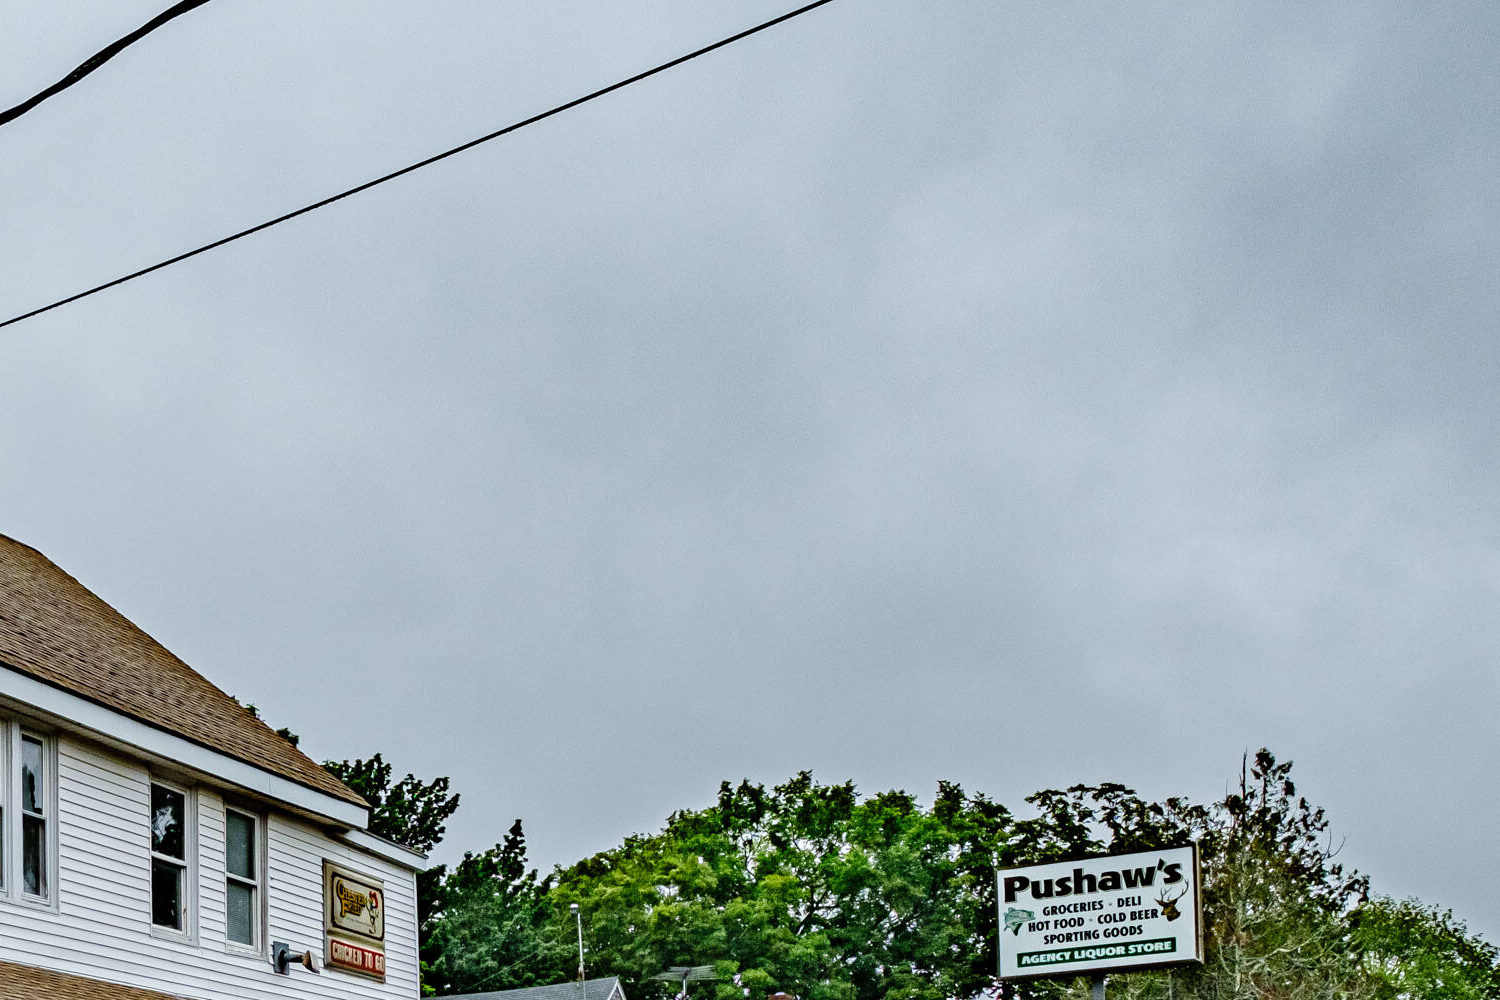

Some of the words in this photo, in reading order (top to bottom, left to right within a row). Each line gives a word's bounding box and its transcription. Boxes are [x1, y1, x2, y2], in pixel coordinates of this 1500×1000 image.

[1004, 858, 1182, 903] Pushaw's
[1042, 900, 1104, 916] GROCERIES
[1117, 895, 1142, 908] DELI
[1028, 921, 1050, 932] HOT
[1054, 917, 1085, 929] FOOD
[1097, 912, 1127, 925] COLD
[1130, 908, 1159, 921] BEER
[1043, 929, 1100, 945] SPORTING
[1103, 925, 1143, 938] GOODS
[332, 942, 362, 966] CHICKEN
[364, 951, 373, 968] TO
[375, 955, 384, 972] GO
[1021, 951, 1072, 965] AGENCY
[1074, 946, 1126, 959] LIQUOR
[1128, 941, 1172, 954] STORE
